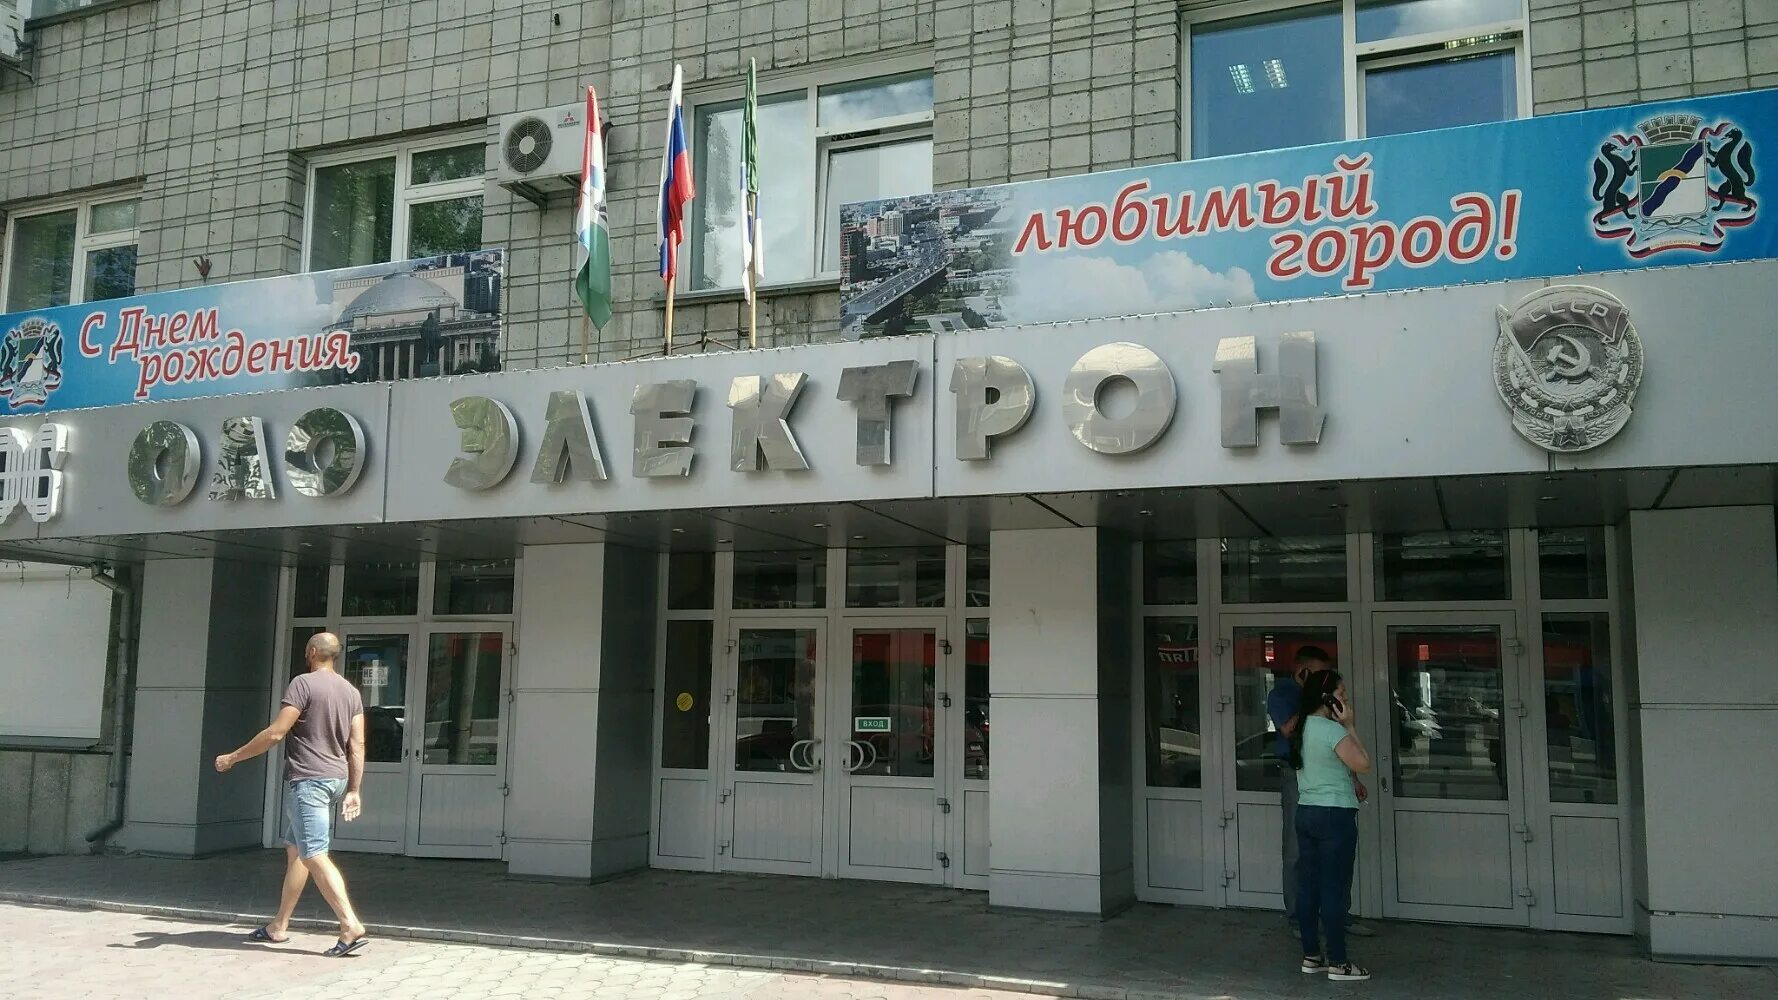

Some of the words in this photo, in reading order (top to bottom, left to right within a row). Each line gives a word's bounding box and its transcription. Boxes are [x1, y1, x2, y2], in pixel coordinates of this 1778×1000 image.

[1014, 156, 1375, 253] любимый
[1270, 194, 1518, 287] город!
[110, 308, 219, 361] Днем
[1528, 301, 1608, 322] СССР
[136, 330, 360, 397] рождения,
[128, 407, 365, 506] ОАО
[443, 331, 1325, 490] ЭЛЕКТРОН
[363, 668, 373, 678] НЕ
[863, 720, 884, 728] ВХОД
